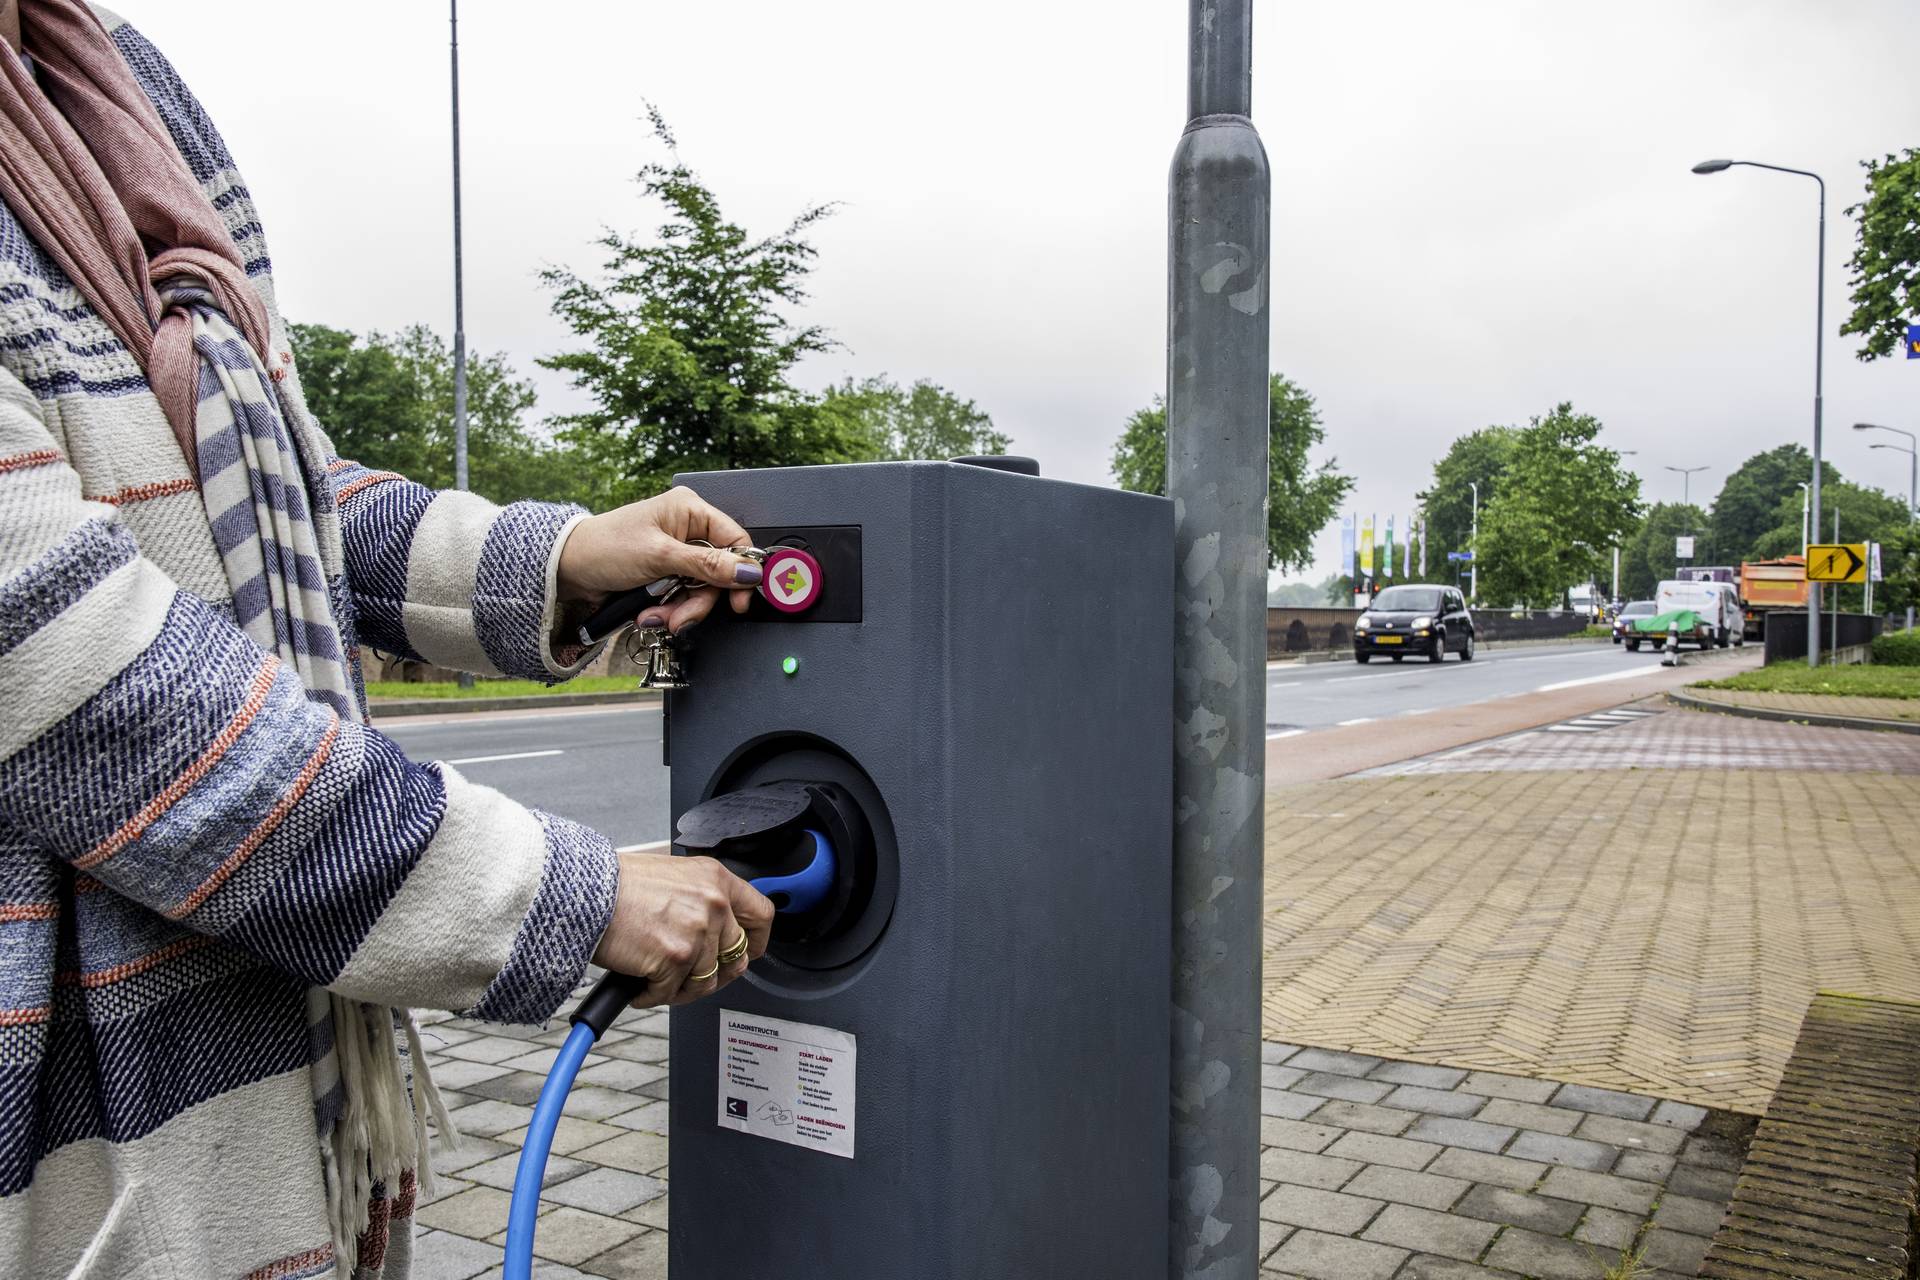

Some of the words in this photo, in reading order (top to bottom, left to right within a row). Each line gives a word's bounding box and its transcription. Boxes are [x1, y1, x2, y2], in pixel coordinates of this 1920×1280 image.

[728, 1021, 779, 1036] LAADINSTRUCTIE
[799, 1051, 814, 1059] START
[815, 1055, 833, 1063] LADEN
[797, 1115, 814, 1123] LADEN
